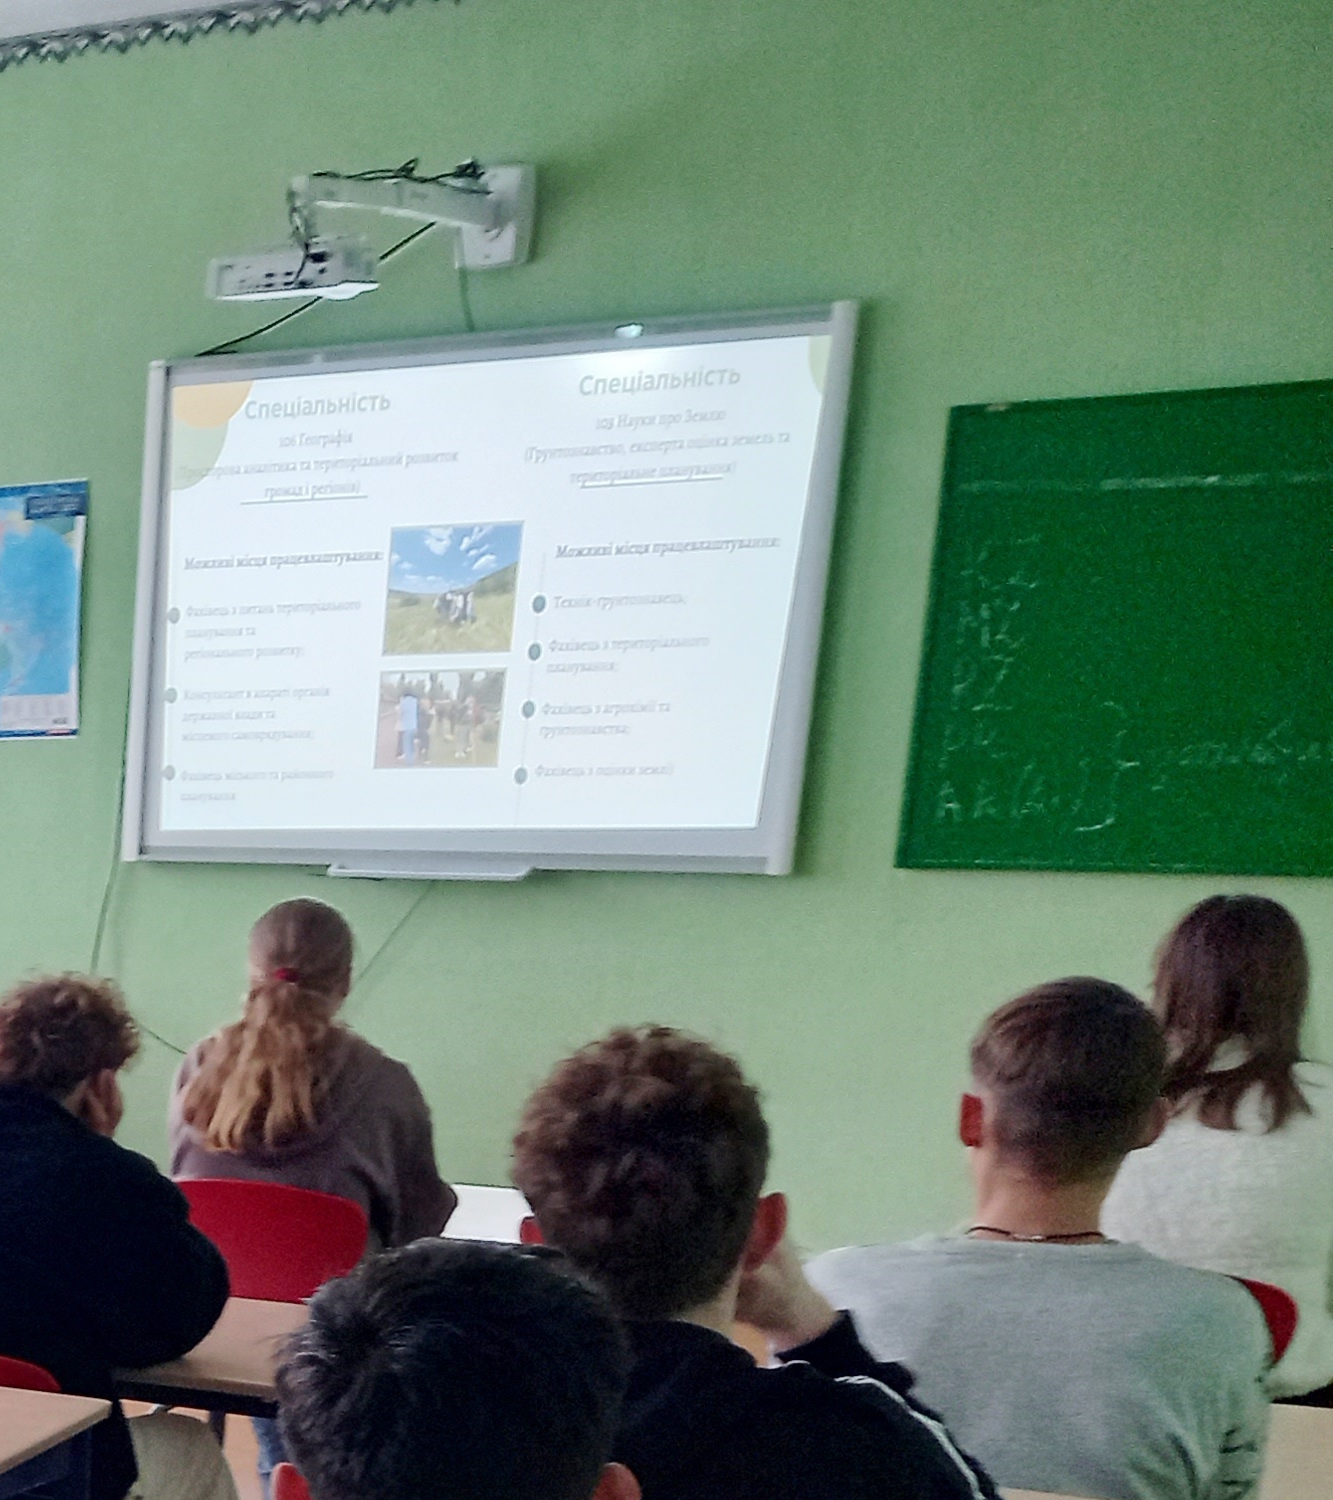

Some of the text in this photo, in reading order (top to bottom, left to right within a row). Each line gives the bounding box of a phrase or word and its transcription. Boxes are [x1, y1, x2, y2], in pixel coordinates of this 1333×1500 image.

[579, 366, 741, 396] Спеціальність
[245, 392, 391, 420] Спеціальність
[617, 414, 656, 430] Науки
[658, 413, 683, 428] про
[299, 430, 352, 447] Географія
